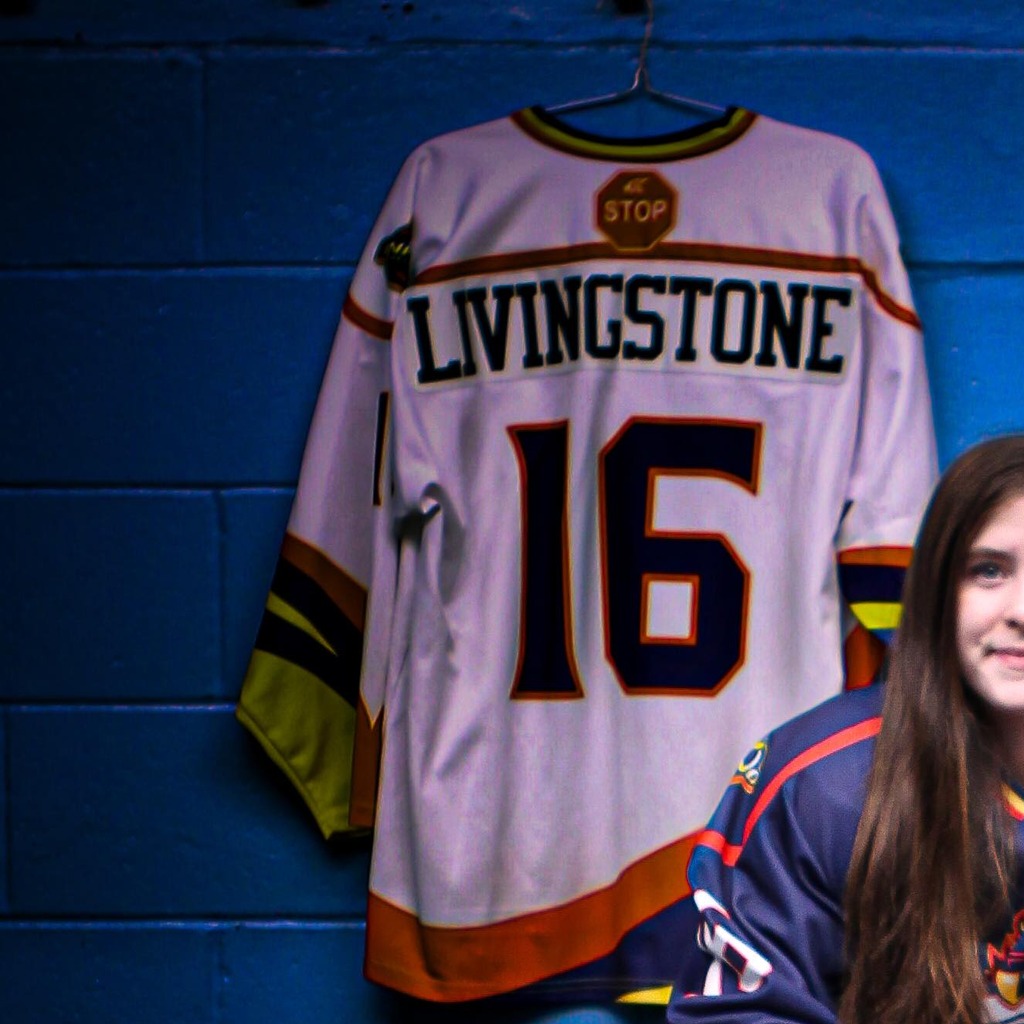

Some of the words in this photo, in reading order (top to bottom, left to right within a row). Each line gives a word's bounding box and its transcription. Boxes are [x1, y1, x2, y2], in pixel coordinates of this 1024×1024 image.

[603, 199, 667, 222] STOP
[407, 274, 852, 383] LIVINGSTONE
[506, 415, 763, 699] 16
